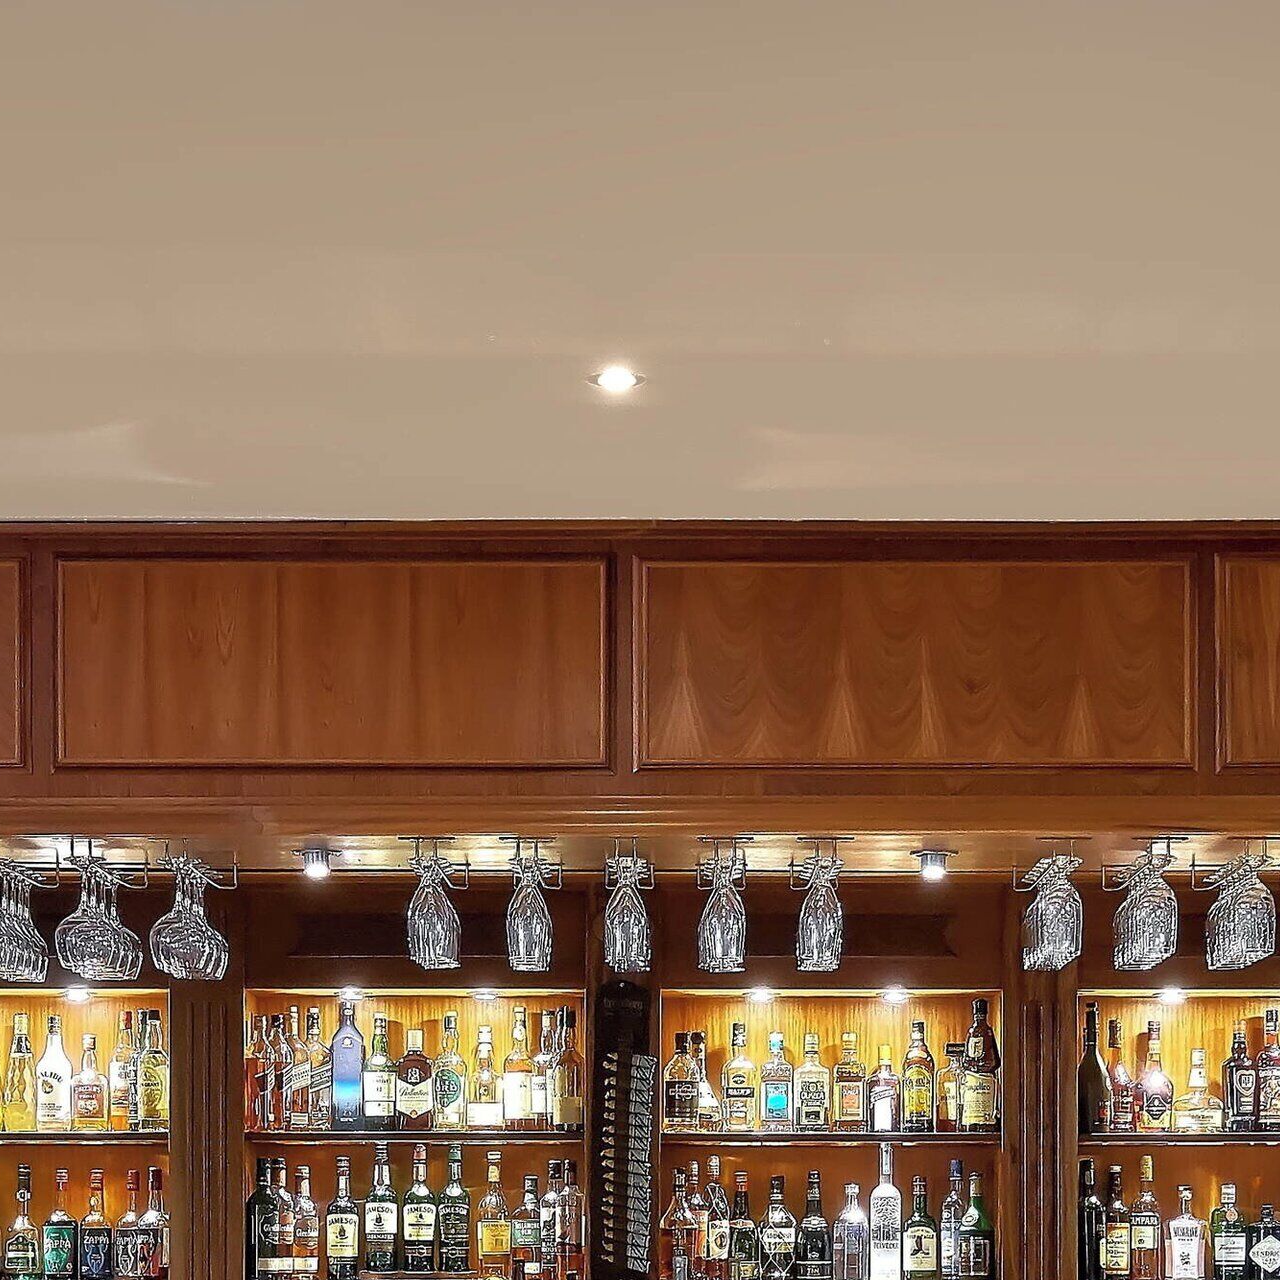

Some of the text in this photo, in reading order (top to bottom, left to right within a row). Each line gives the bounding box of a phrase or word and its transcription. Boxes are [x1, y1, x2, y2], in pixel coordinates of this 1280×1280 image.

[366, 1207, 394, 1215] JAMESON
[328, 1218, 358, 1227] JAMESON
[84, 1235, 110, 1244] ZAPPA
